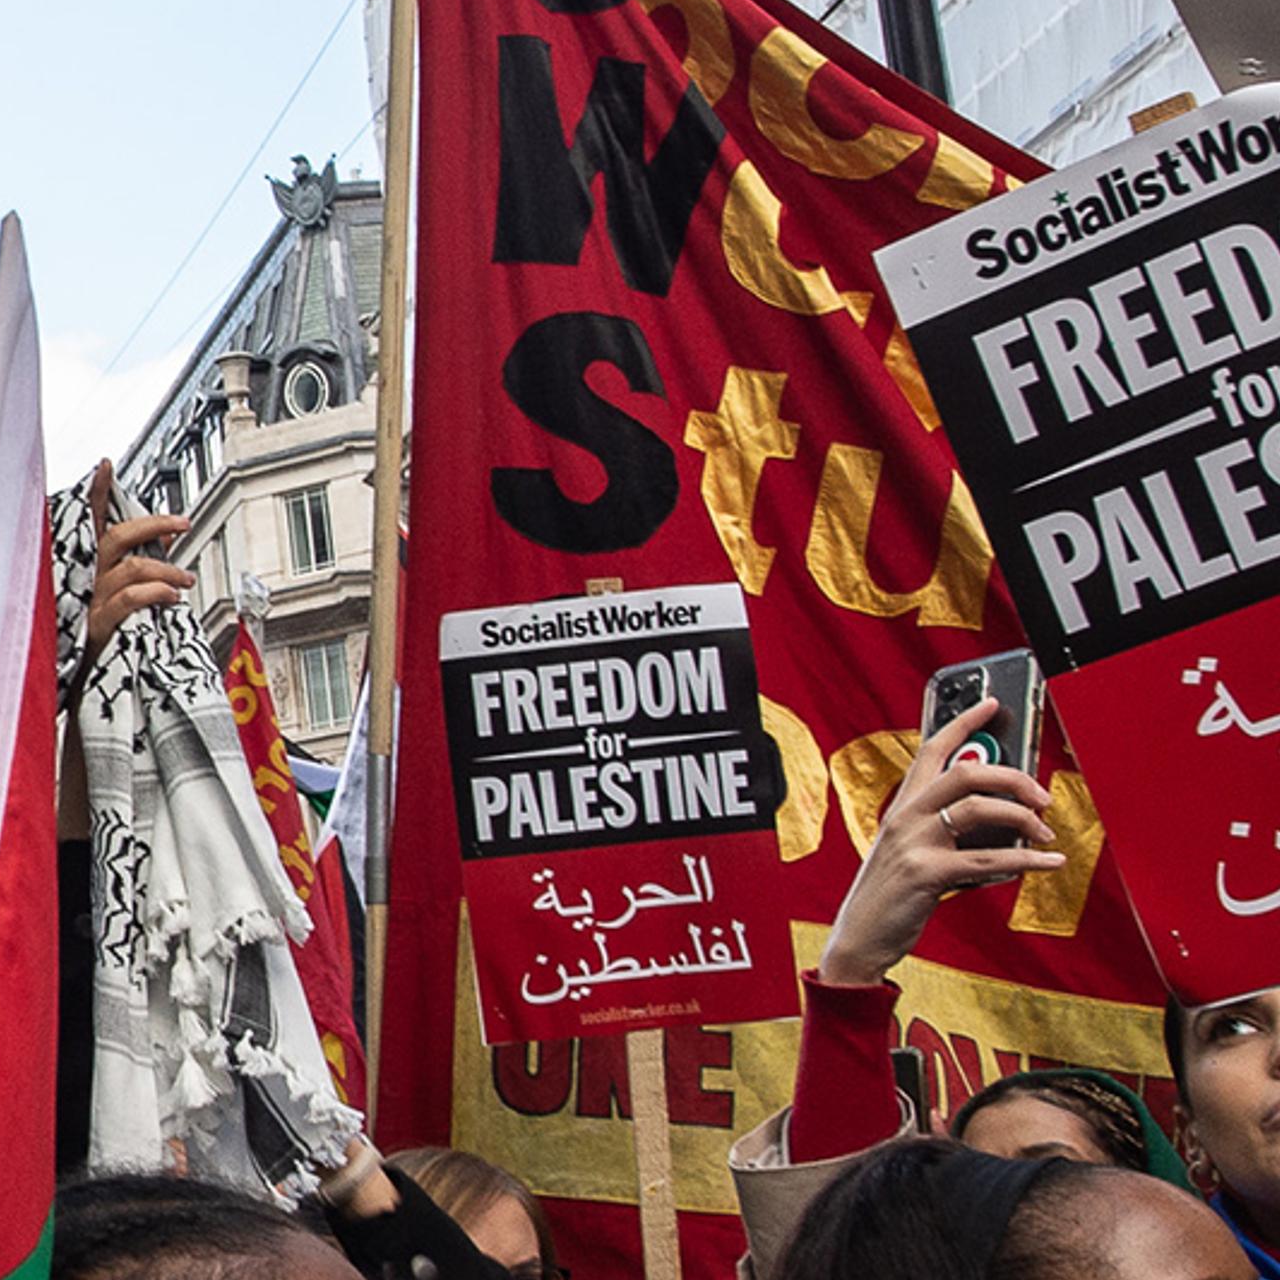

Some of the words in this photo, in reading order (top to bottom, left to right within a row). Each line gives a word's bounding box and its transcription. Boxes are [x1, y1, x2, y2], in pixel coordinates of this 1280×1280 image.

[470, 646, 728, 738] FREEDOM
[584, 726, 629, 761] for
[470, 749, 757, 843] PALESTINE
[531, 854, 715, 931] الحرية
[519, 917, 753, 1005] لفلسطين
